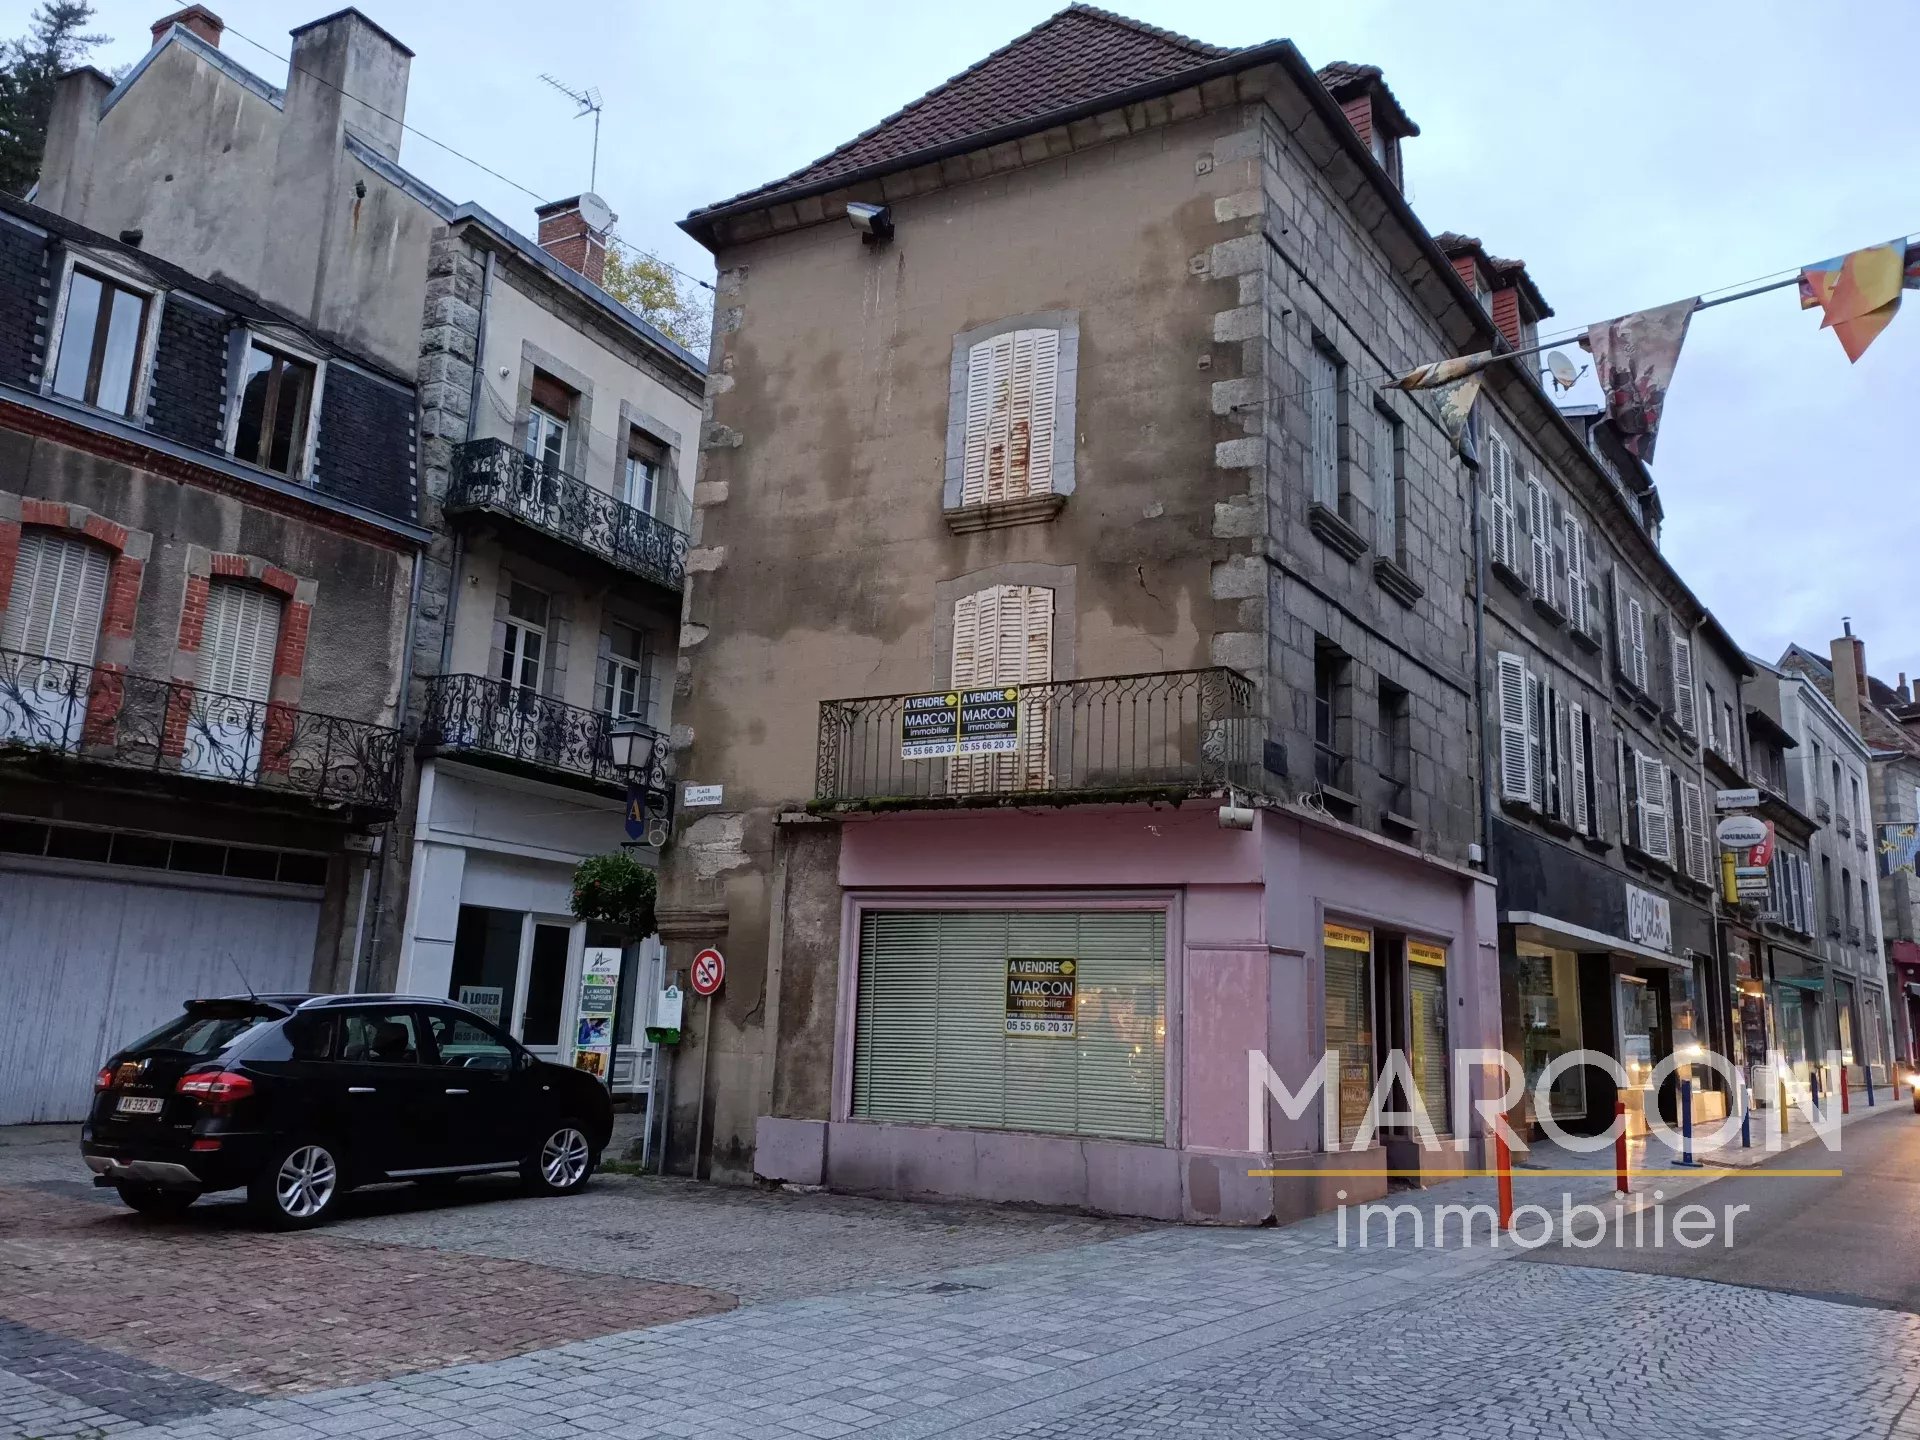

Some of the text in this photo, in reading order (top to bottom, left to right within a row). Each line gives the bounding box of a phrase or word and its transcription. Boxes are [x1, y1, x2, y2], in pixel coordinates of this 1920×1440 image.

[904, 696, 945, 709] A VENDRE
[962, 690, 1004, 704] A VENDRE
[905, 711, 956, 727] MARCON
[962, 706, 1015, 721] MARCON
[910, 726, 950, 736] immobilier
[967, 721, 1009, 732] immobilier
[902, 744, 956, 756] 05 55 66 20 37
[960, 740, 1016, 752] 05 55 66 20 37
[628, 799, 641, 822] A
[1720, 833, 1761, 841] JOURNAUX
[1010, 961, 1060, 973] A VENDRE
[1010, 980, 1073, 996] MARCON
[470, 992, 500, 1005] LOUER
[1016, 997, 1066, 1008] immobilier
[1006, 1020, 1073, 1032] 05 55 66 20 37
